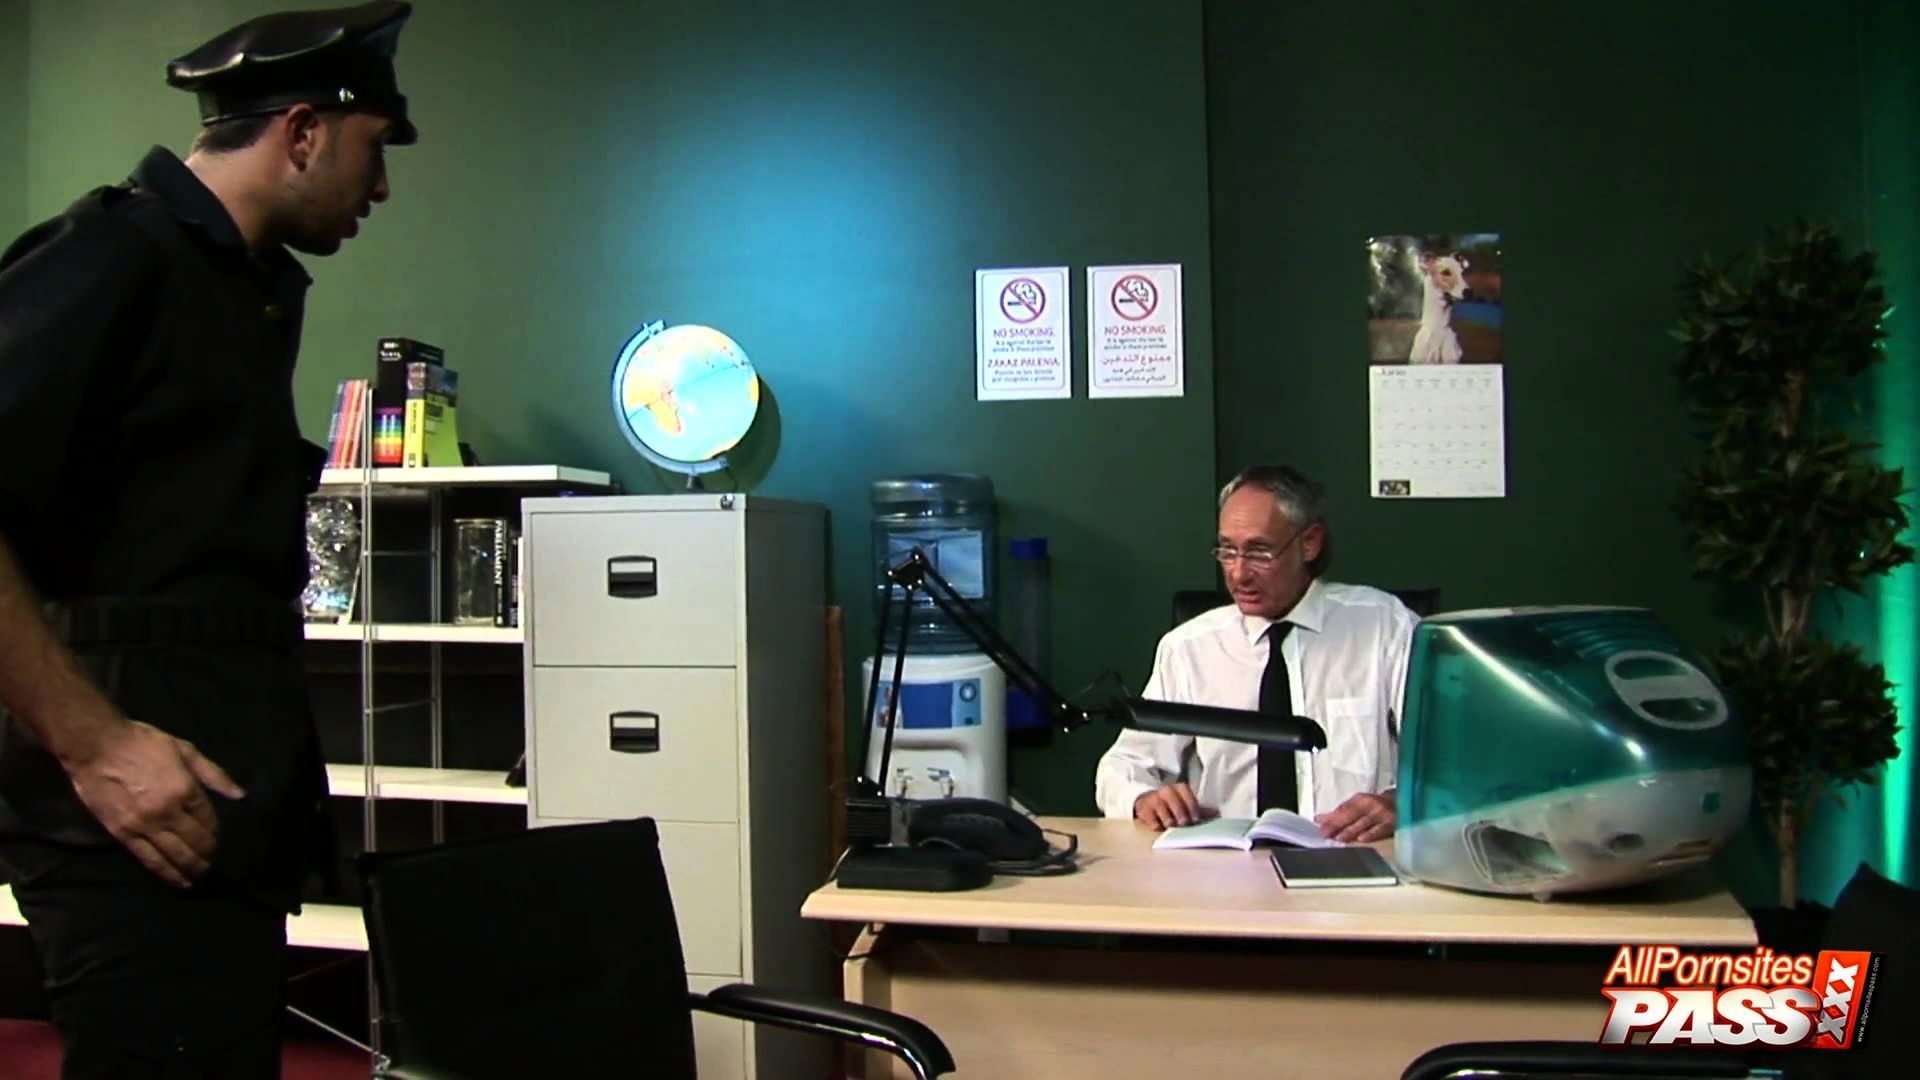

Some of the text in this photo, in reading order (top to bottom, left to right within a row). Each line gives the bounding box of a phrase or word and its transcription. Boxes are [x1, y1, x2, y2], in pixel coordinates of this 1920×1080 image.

[993, 328, 1007, 338] NO
[1104, 326, 1119, 335] NO
[988, 359, 1018, 368] ZAKAZ
[494, 520, 503, 585] PARLIAMENT
